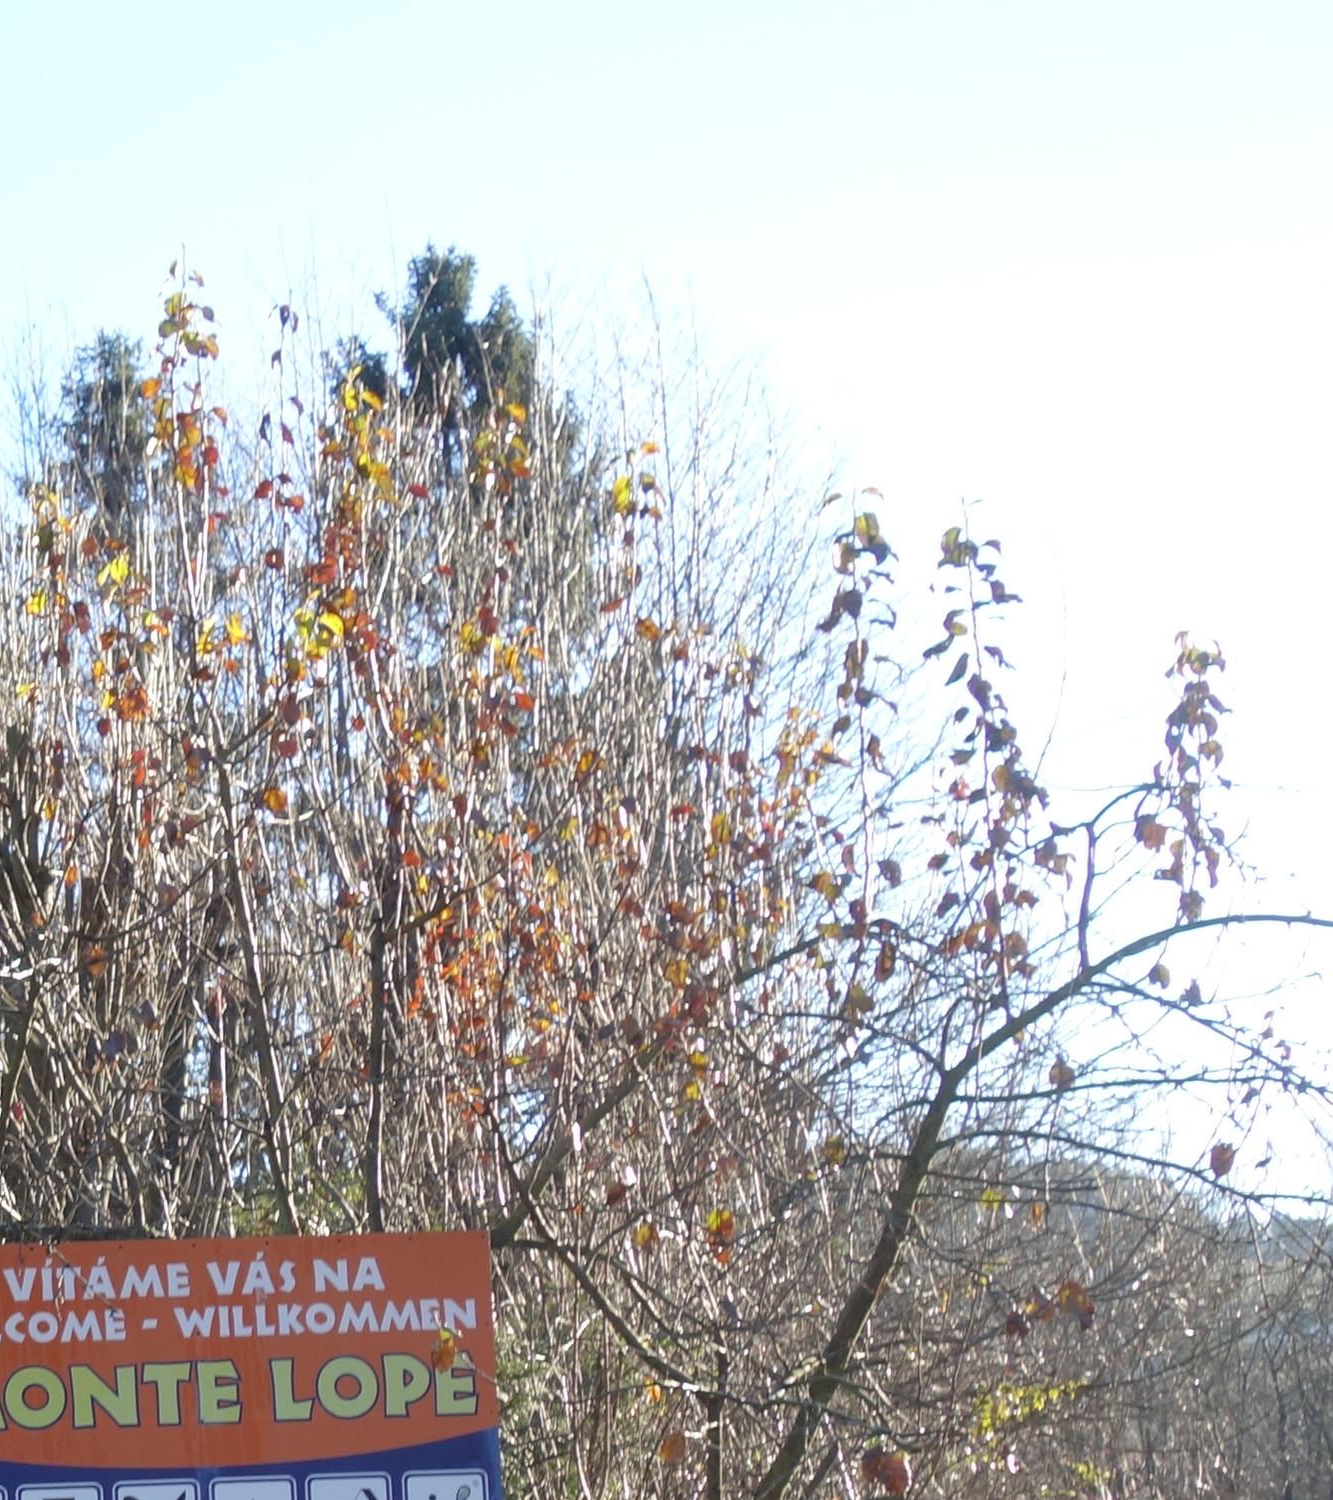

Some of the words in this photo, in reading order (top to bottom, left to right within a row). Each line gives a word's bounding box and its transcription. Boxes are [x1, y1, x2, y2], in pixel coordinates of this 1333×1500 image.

[2, 1256, 191, 1302] VÍTÁME
[206, 1251, 296, 1296] VÁS
[313, 1256, 385, 1293] NA
[173, 1298, 476, 1338] WILLKOMMEN
[269, 1351, 479, 1423] LOPE
